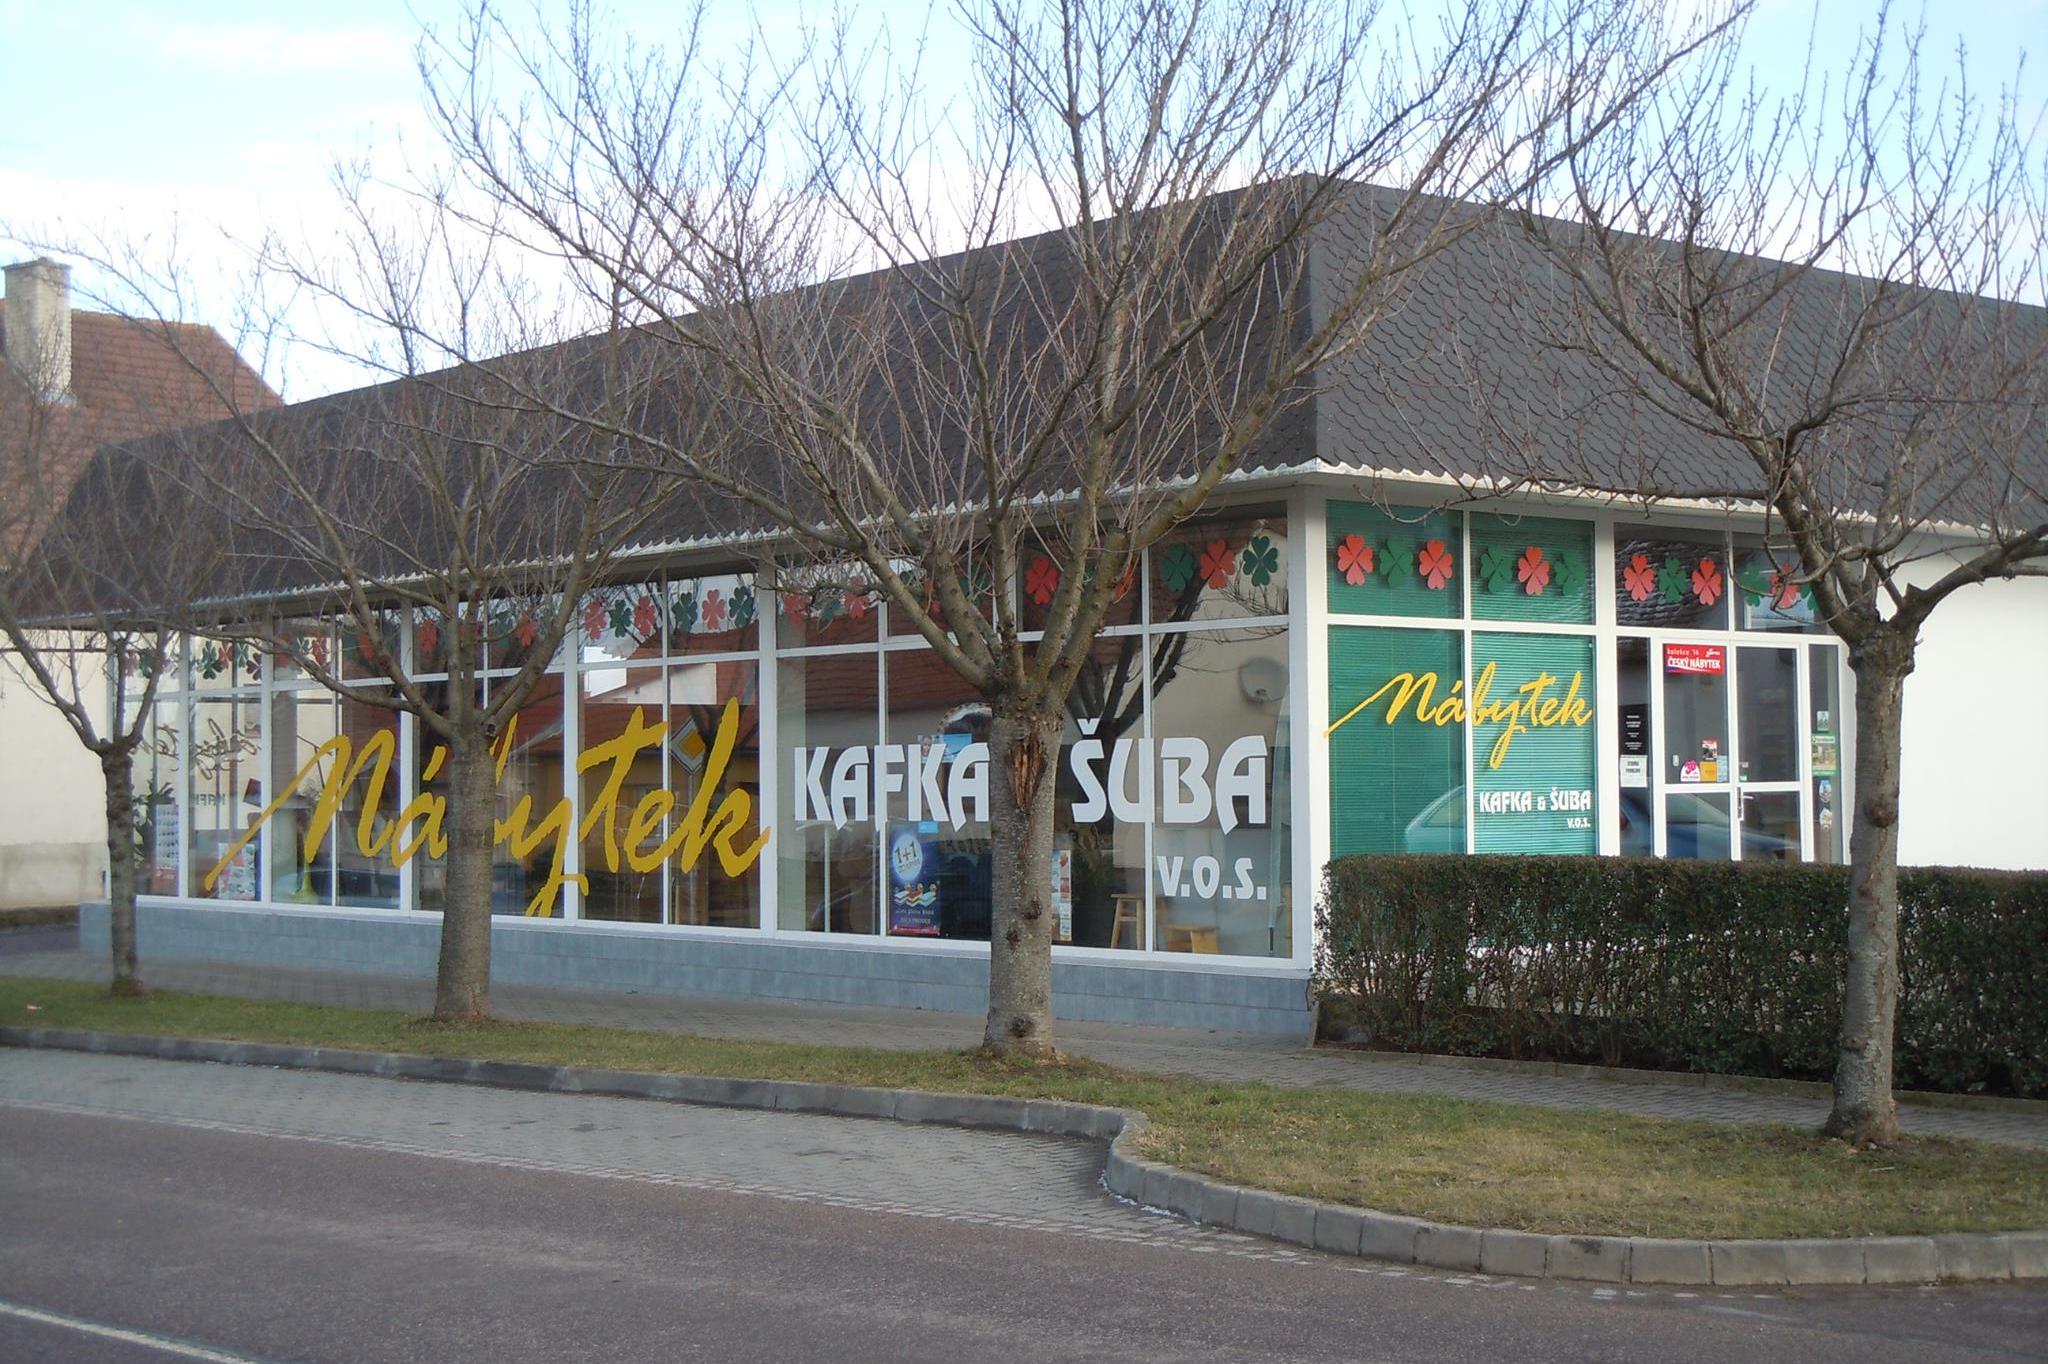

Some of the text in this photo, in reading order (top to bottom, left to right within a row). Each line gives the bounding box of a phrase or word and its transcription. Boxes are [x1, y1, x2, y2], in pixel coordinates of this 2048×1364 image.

[1667, 655, 1721, 670] ČESKÝ NÁBYTEK
[1323, 661, 1593, 769] Nábytek
[204, 696, 772, 917] Náytek
[794, 717, 1268, 835] KAFKA ŠUBA
[1480, 791, 1532, 815] KAFKA
[1550, 787, 1592, 812] ŠUBA
[895, 841, 918, 864] 1+1
